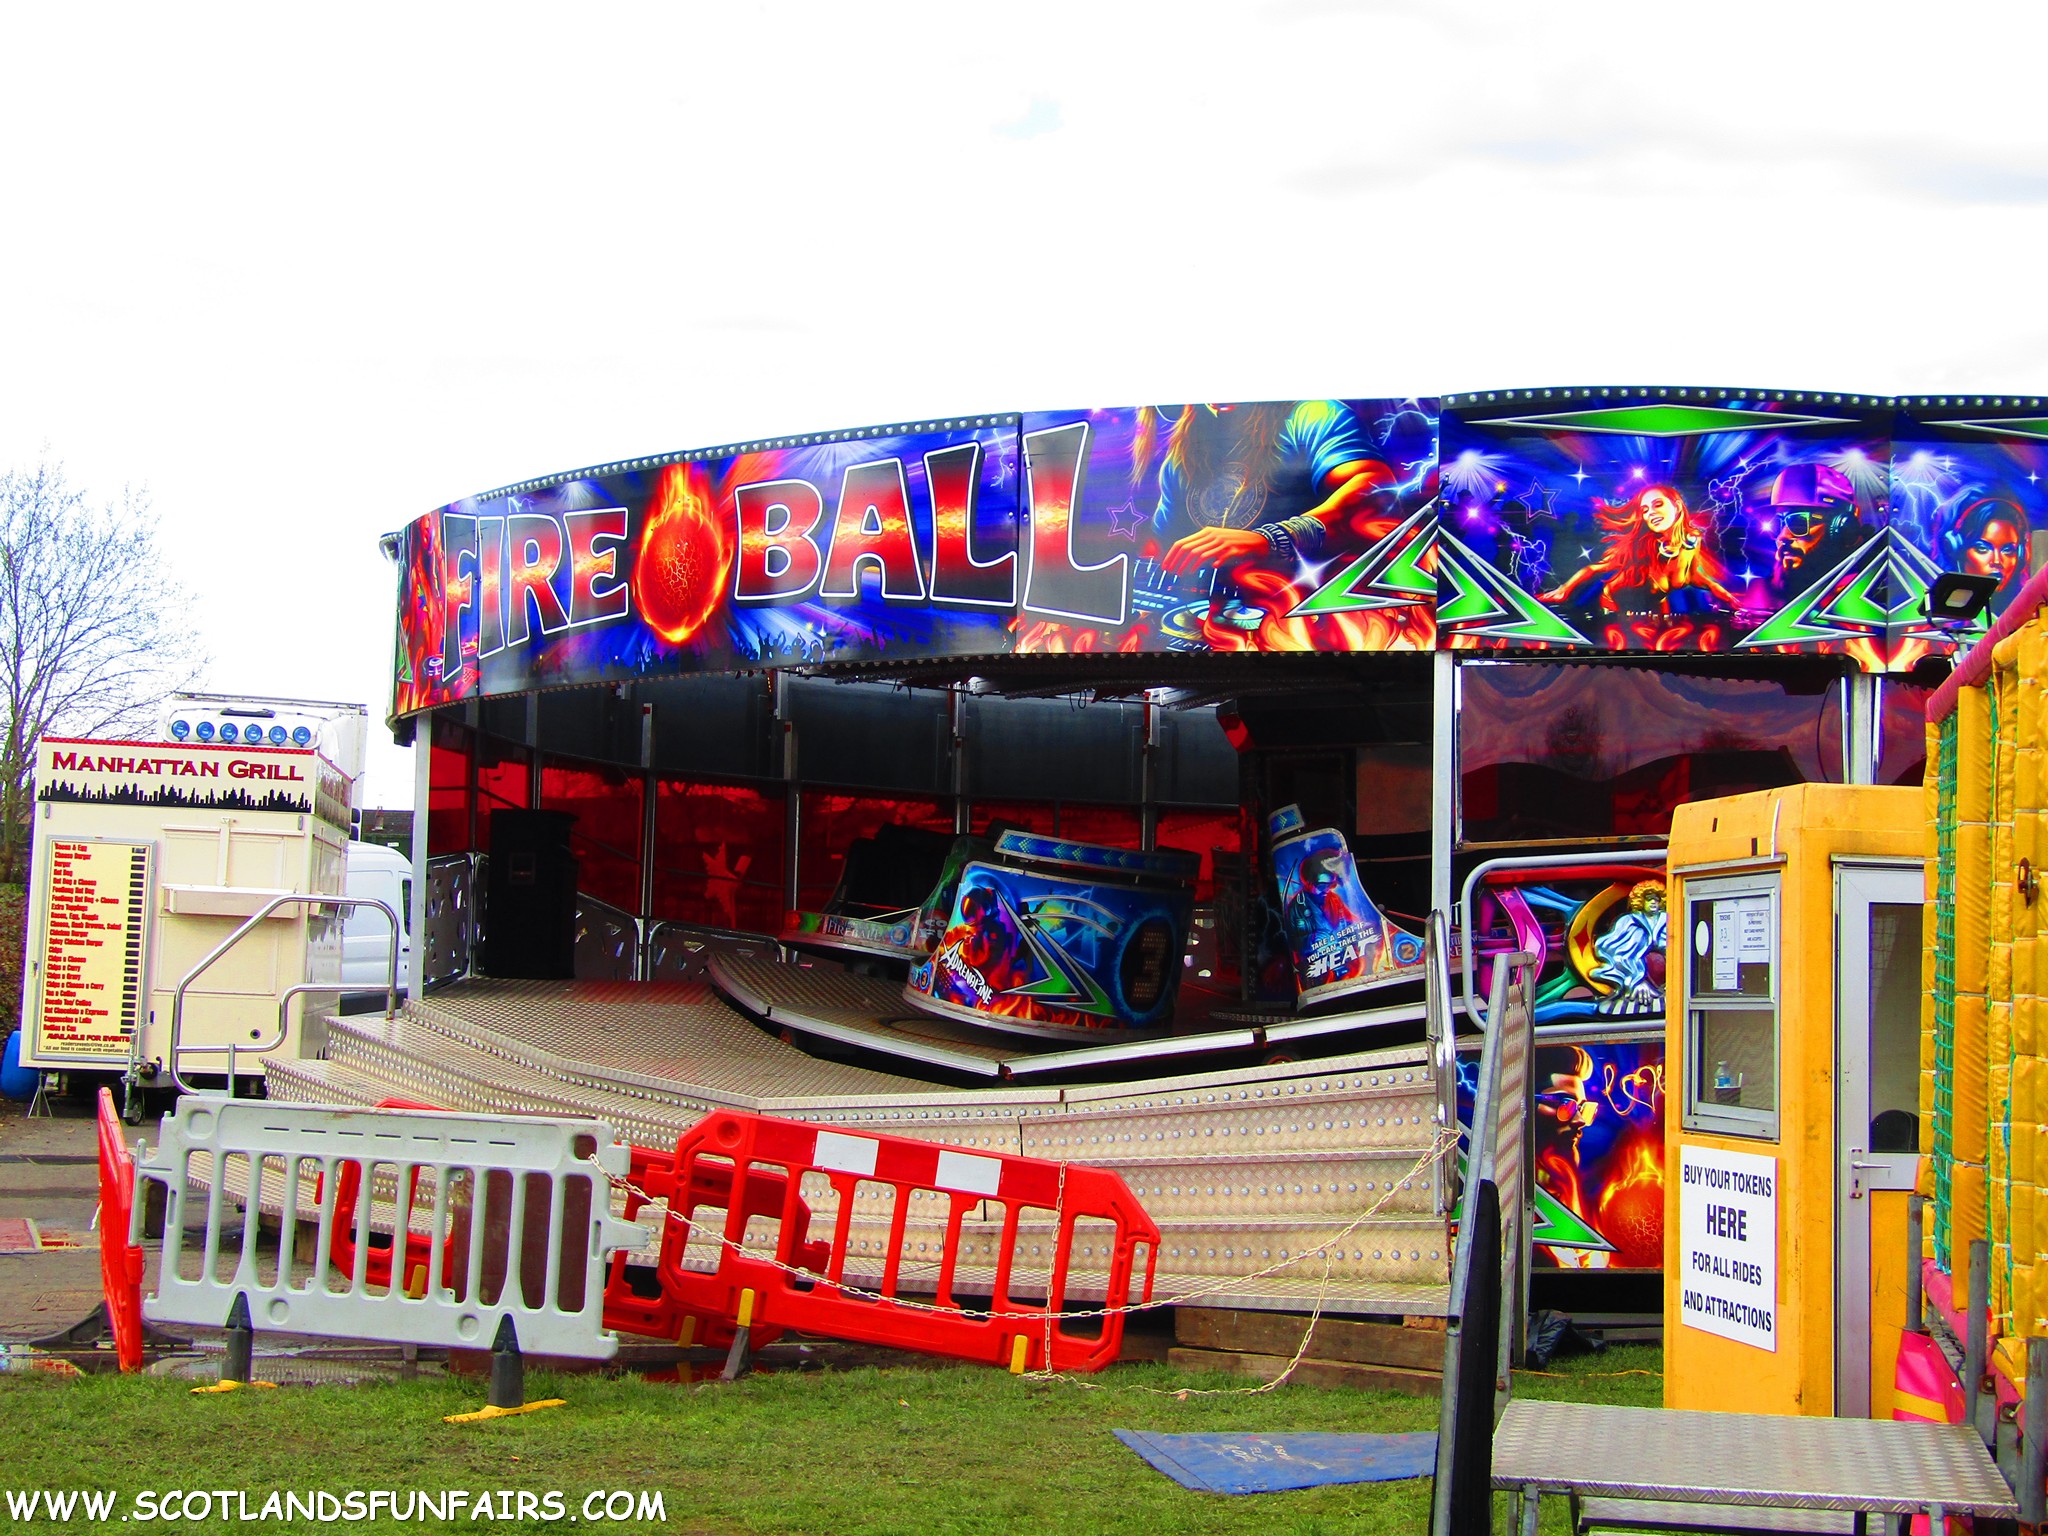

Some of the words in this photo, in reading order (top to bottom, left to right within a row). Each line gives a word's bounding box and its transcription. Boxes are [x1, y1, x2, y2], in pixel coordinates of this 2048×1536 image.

[441, 506, 630, 683] FIRE
[733, 420, 1129, 626] BALL
[1306, 934, 1382, 979] HEAT
[1311, 937, 1328, 951] TAKE
[1330, 934, 1335, 944] A
[1339, 935, 1357, 949] TAKE
[1359, 927, 1374, 939] THE
[921, 972, 928, 987] 3
[939, 938, 993, 1005] ADRENALINE
[46, 1033, 85, 1041] AVAILABLE
[86, 1034, 101, 1042] FOR
[1684, 1164, 1702, 1185] BUY
[1705, 1167, 1730, 1191] YOUR
[1732, 1171, 1772, 1198] TOKENS
[1706, 1203, 1747, 1242] HERE
[1692, 1250, 1711, 1272] FOR
[1712, 1256, 1731, 1279] ALL
[1732, 1260, 1762, 1287] RIDES
[1683, 1289, 1703, 1313] AND
[1705, 1295, 1772, 1333] ATTRACTIONS
